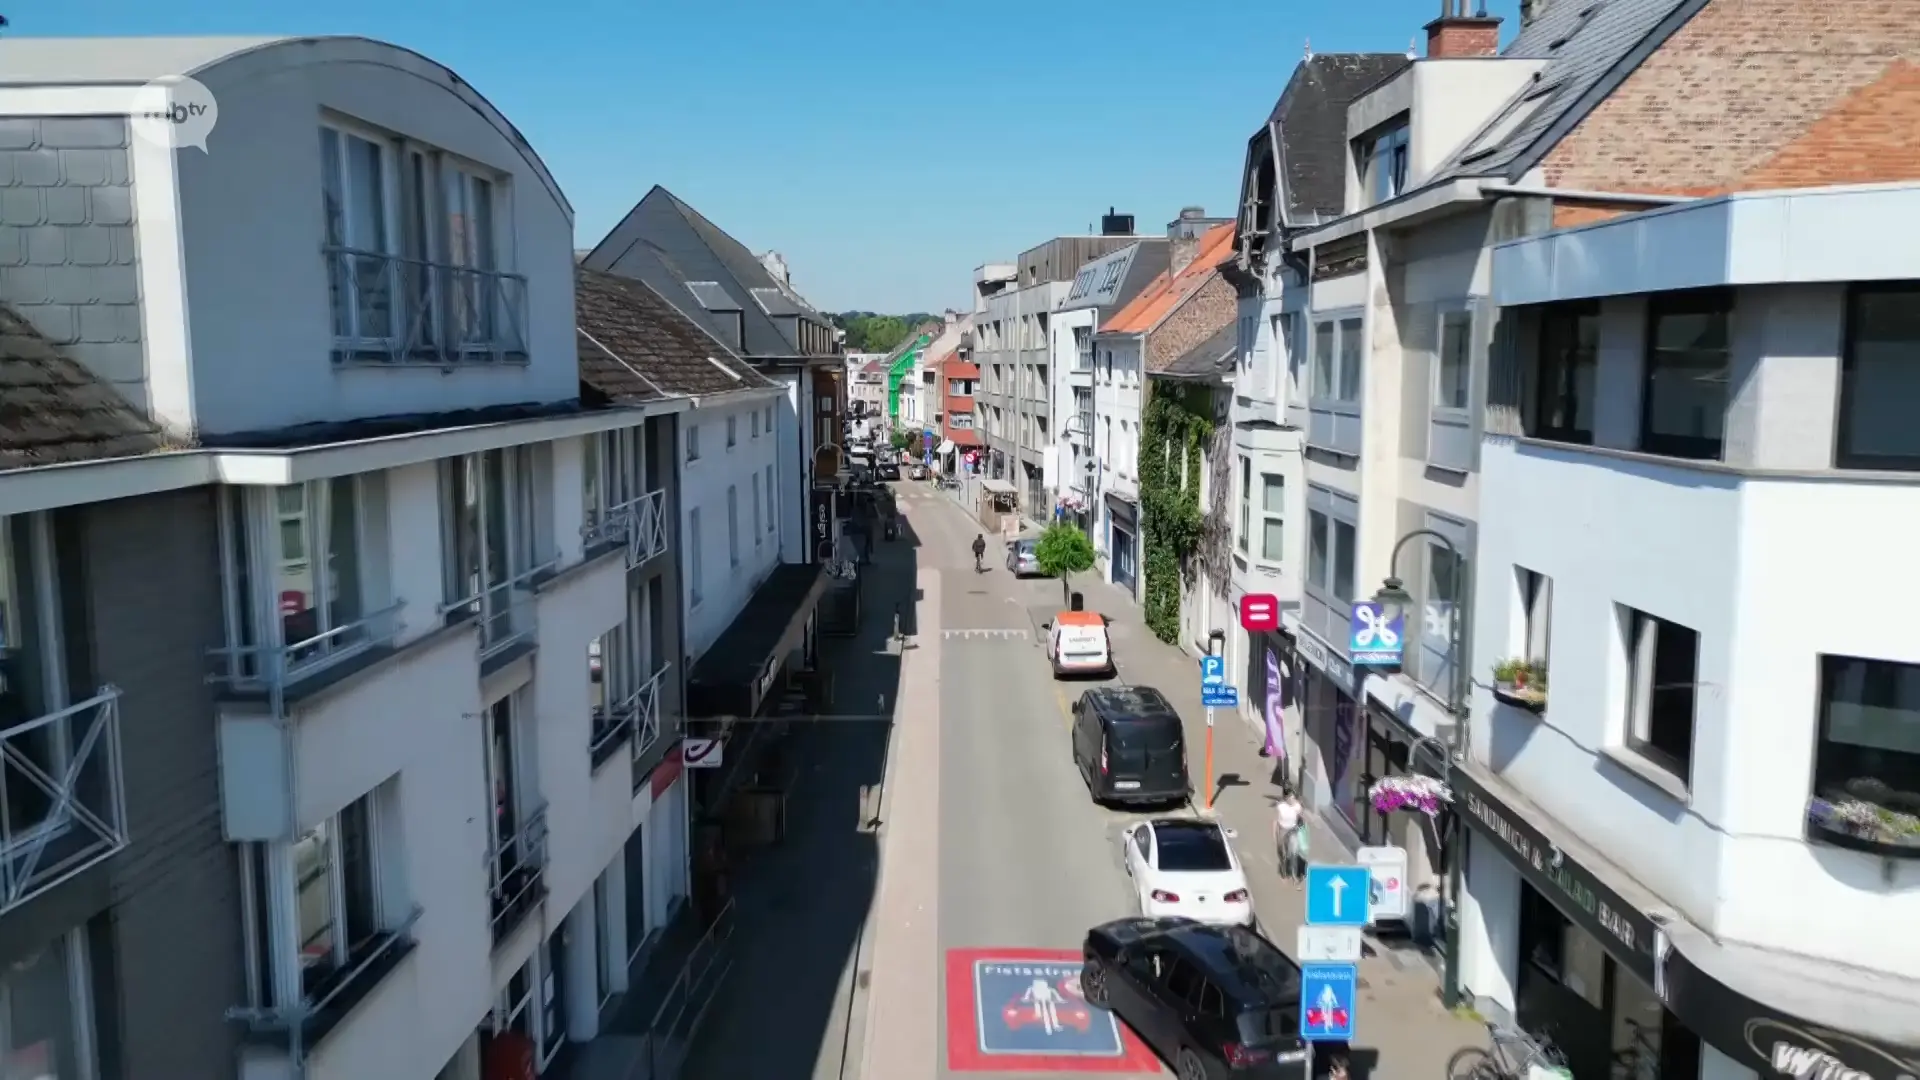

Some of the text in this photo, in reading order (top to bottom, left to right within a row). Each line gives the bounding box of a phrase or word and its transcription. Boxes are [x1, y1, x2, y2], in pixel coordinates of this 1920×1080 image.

[1207, 659, 1218, 675] P
[1467, 792, 1530, 860] SANDWICH
[1598, 901, 1635, 950] BAR
